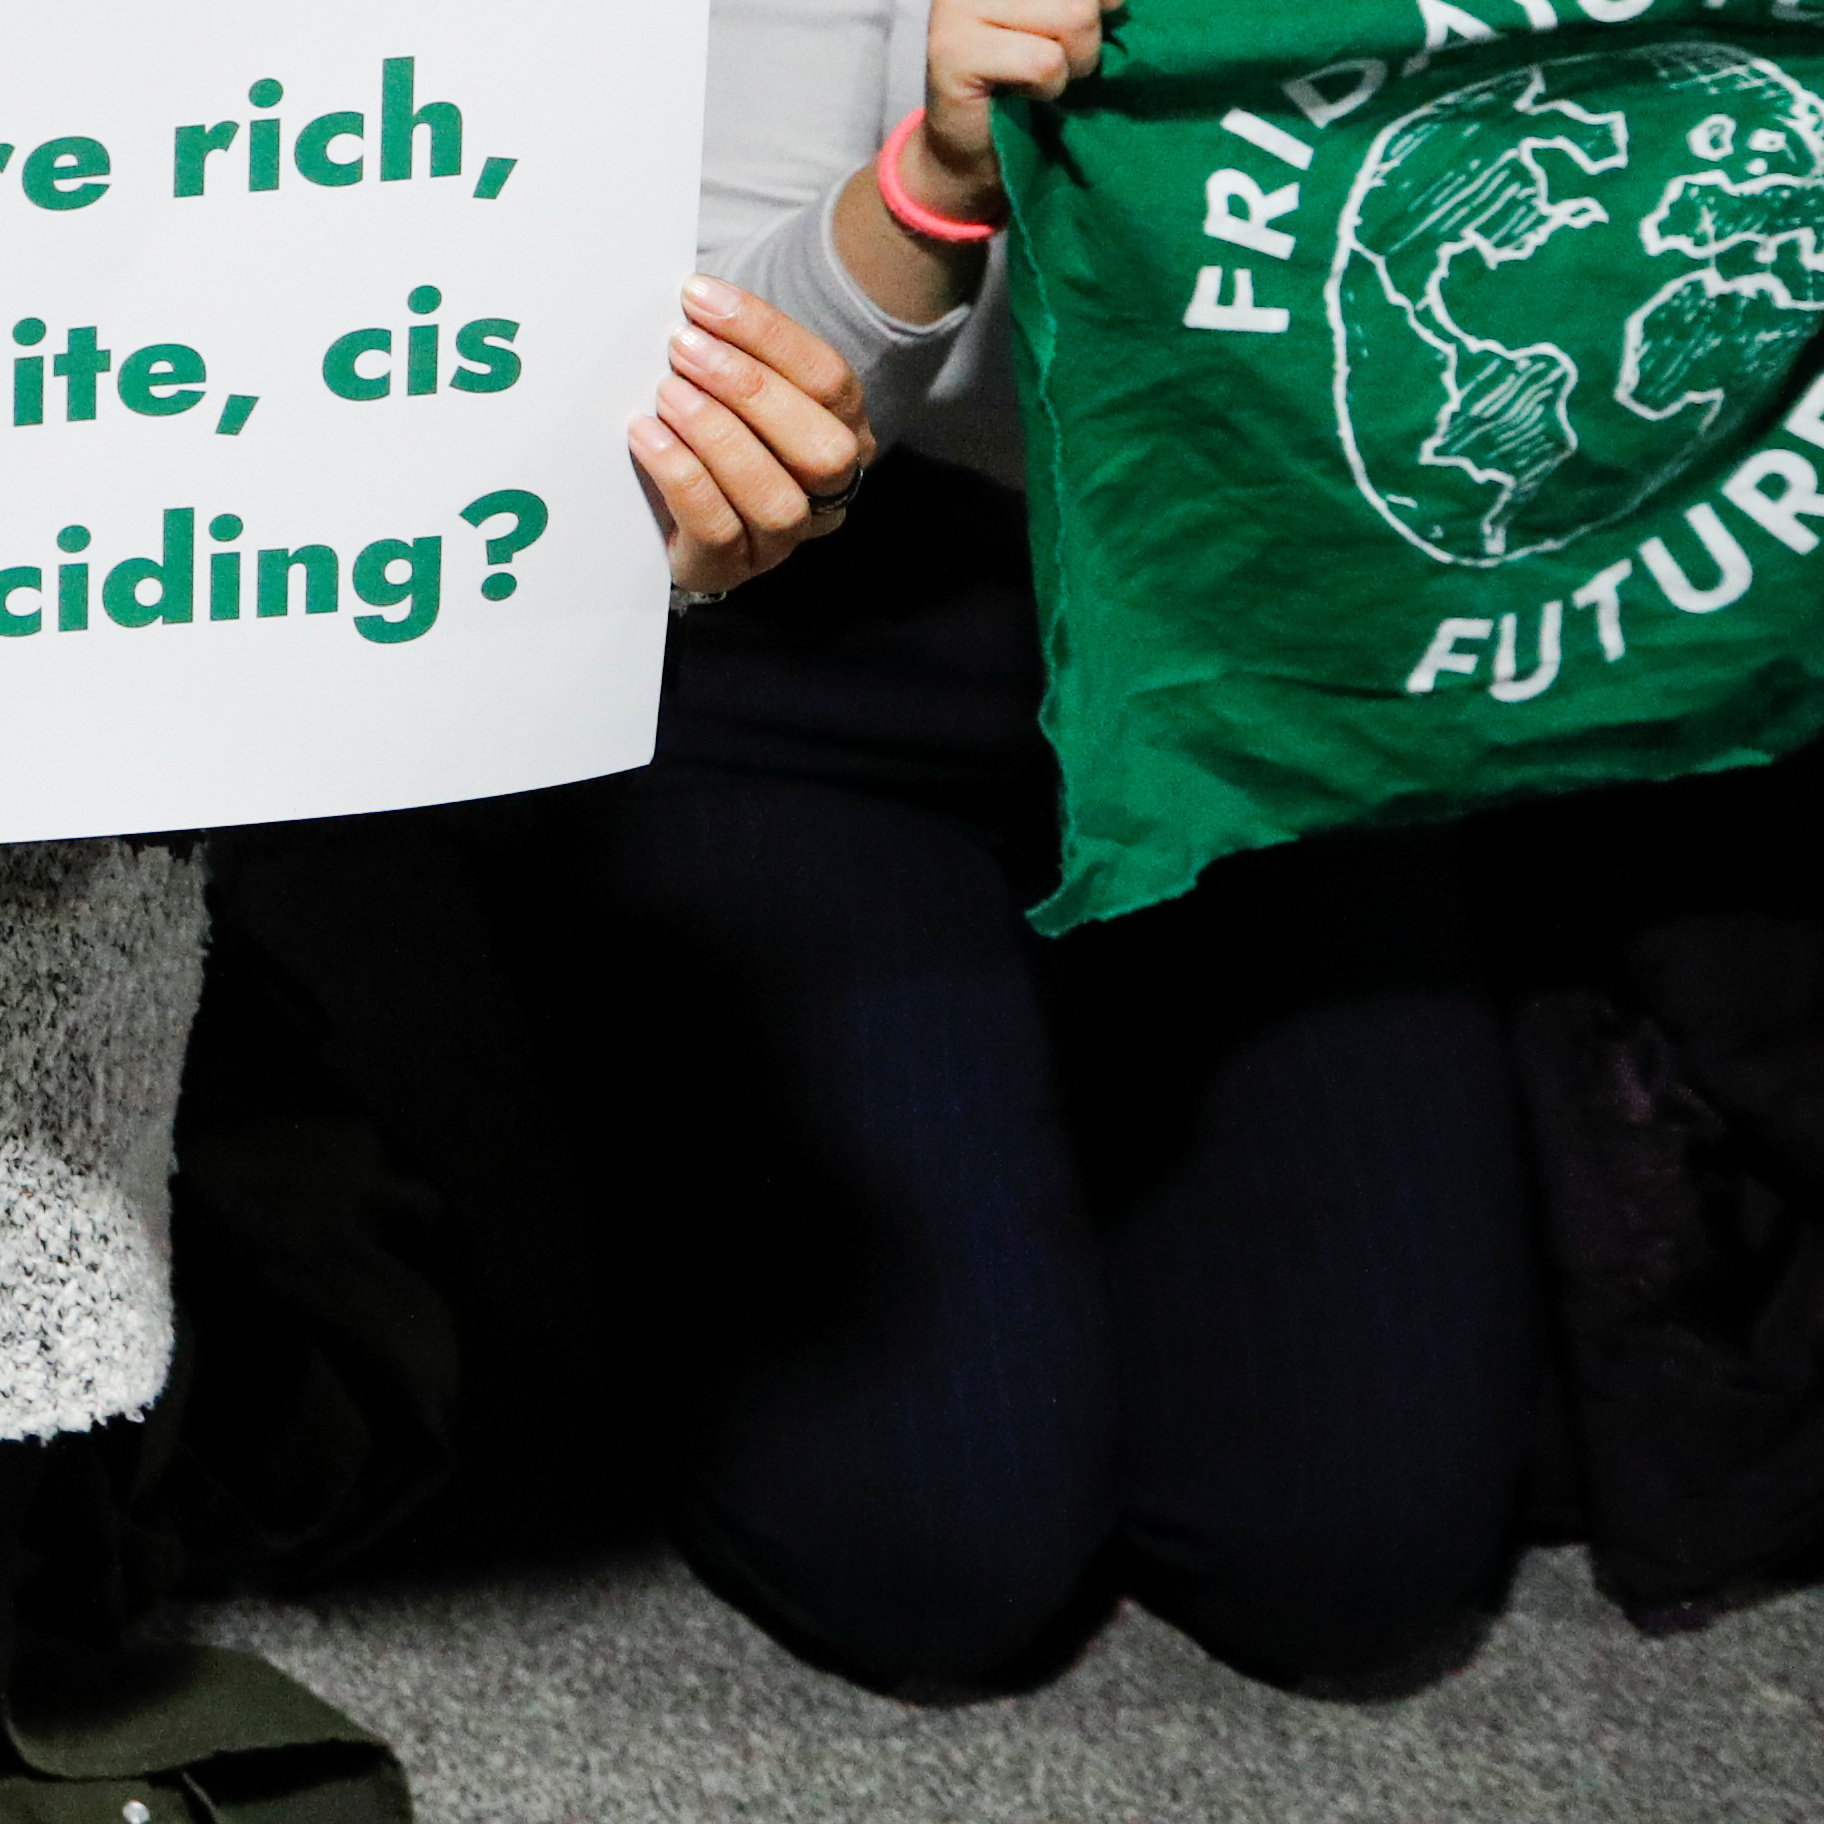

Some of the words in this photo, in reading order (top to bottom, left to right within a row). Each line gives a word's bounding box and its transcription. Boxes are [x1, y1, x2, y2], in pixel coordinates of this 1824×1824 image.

[173, 57, 518, 200] rich,
[322, 286, 522, 402] cis
[1406, 371, 1824, 702] FUTUR
